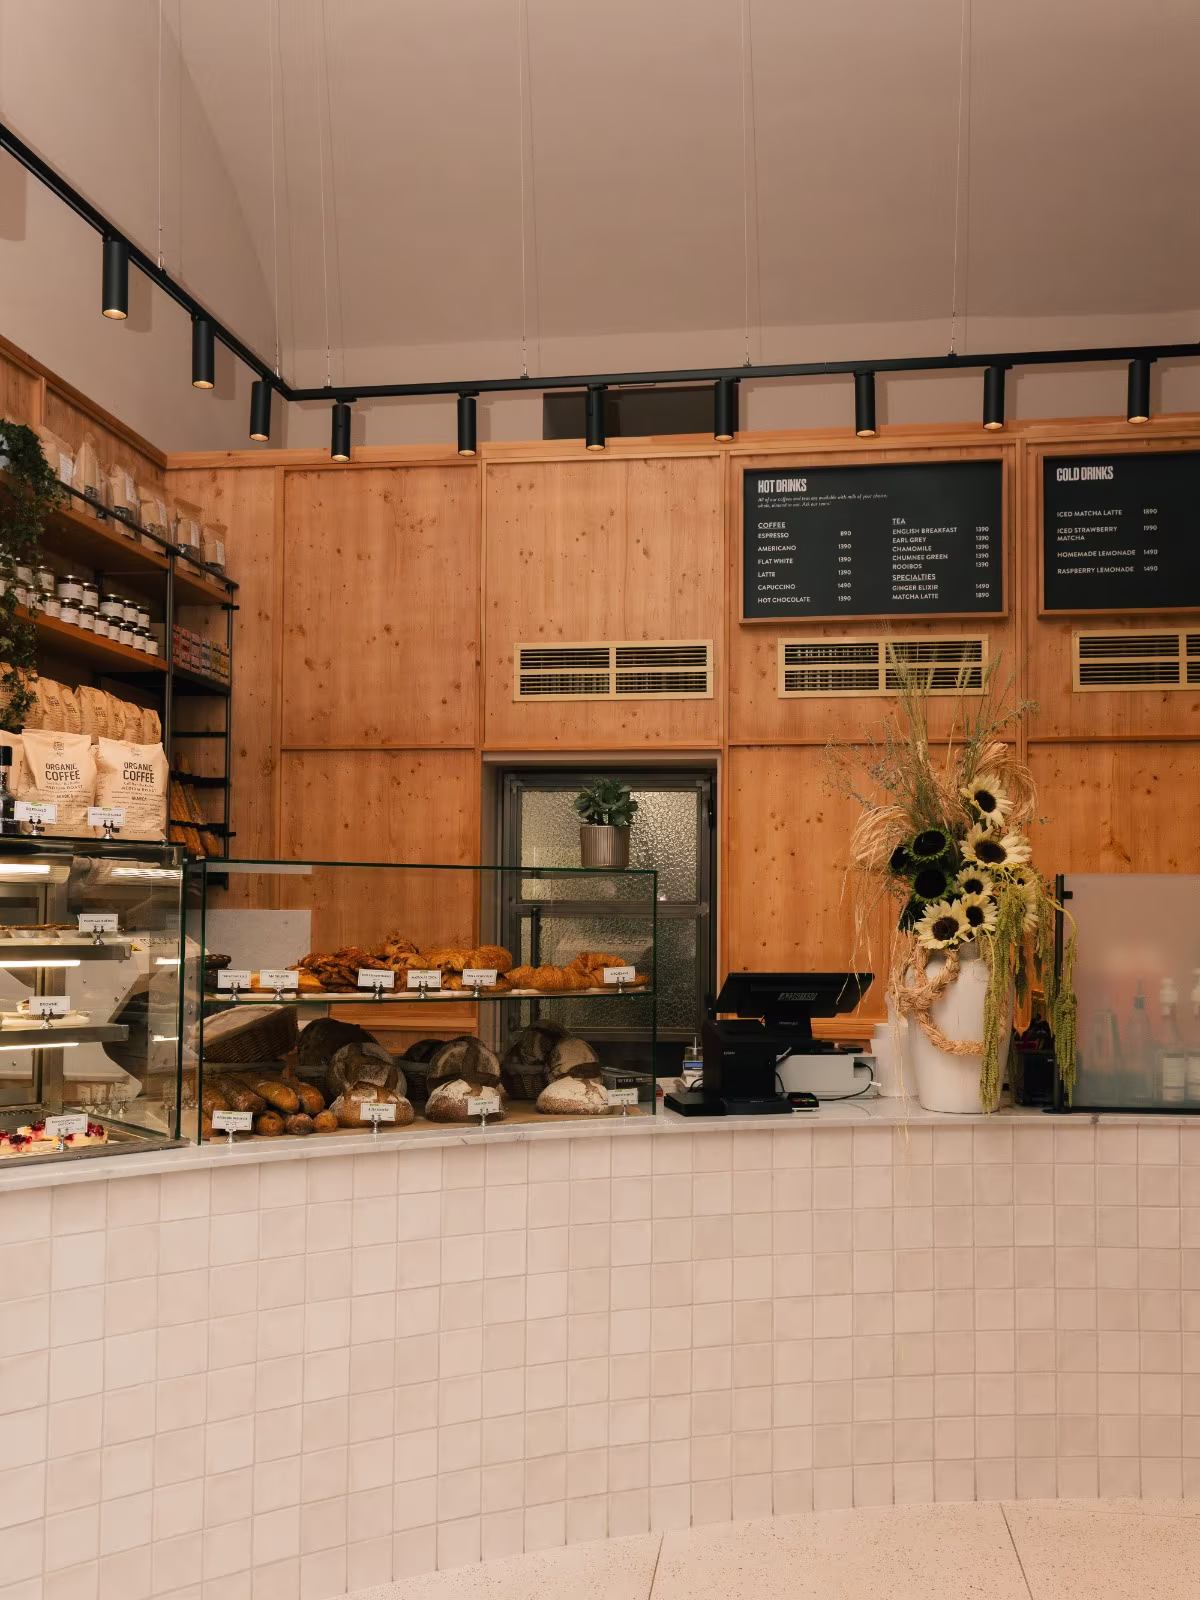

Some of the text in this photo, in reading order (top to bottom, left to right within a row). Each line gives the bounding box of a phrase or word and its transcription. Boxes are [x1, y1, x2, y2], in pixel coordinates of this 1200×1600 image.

[1057, 466, 1113, 481] COLD DRINKS
[758, 479, 807, 493] HOT DRINKS
[124, 762, 153, 771] ORGANIC
[46, 770, 80, 781] COFFEE
[123, 770, 154, 783] COFFEE
